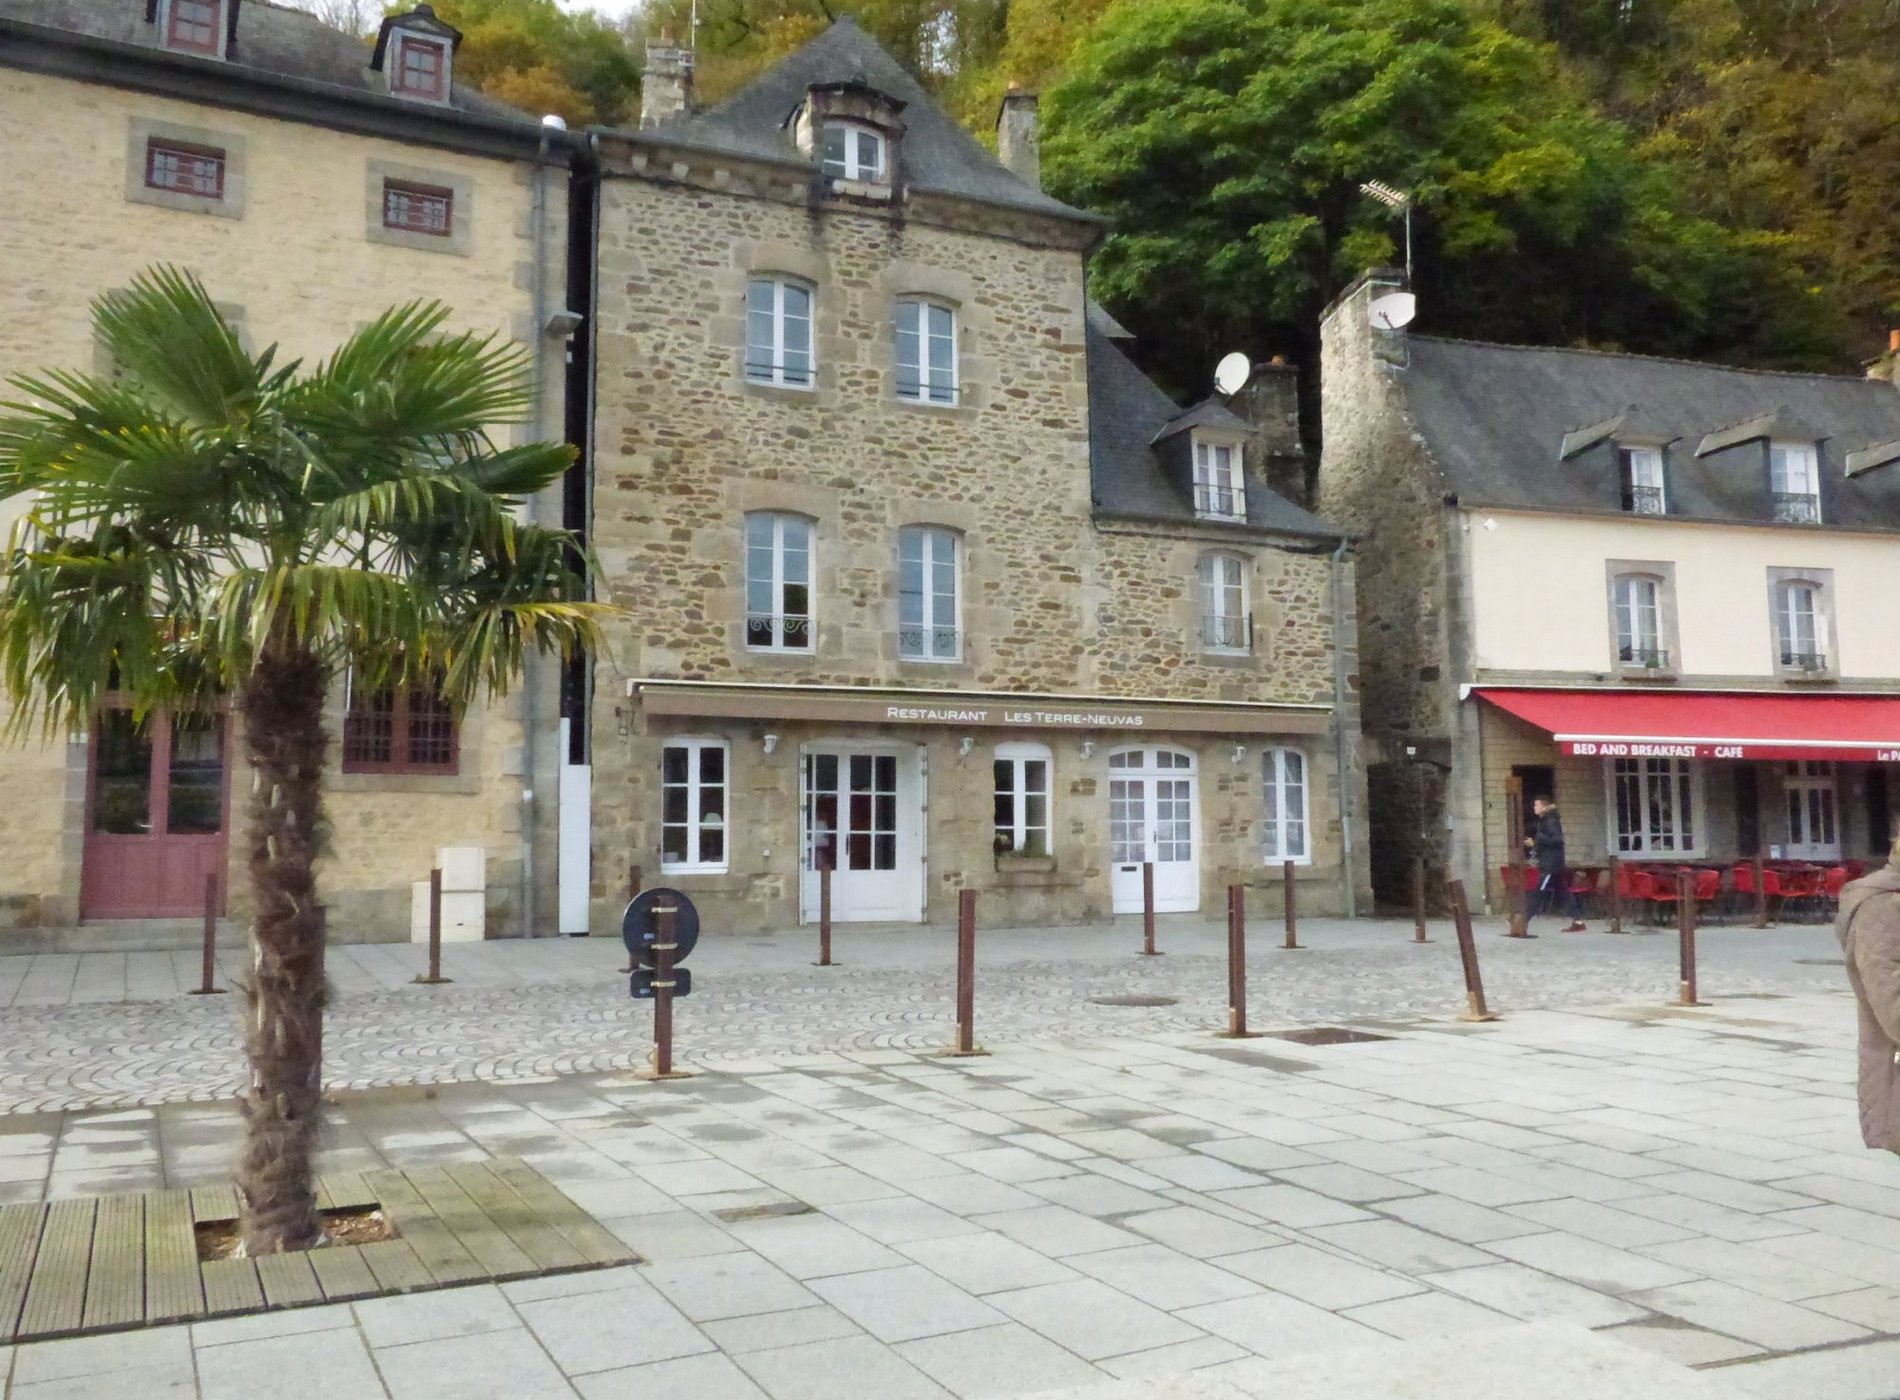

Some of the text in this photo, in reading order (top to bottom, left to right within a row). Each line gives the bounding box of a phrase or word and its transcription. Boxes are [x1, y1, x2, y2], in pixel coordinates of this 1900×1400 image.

[887, 707, 1143, 725] RESTAURANT LES TERRE-NEUVAS
[1573, 743, 1596, 754] BED
[1600, 744, 1628, 755] AND
[1631, 744, 1696, 757] BREAKFAST
[1877, 750, 1890, 761] Le
